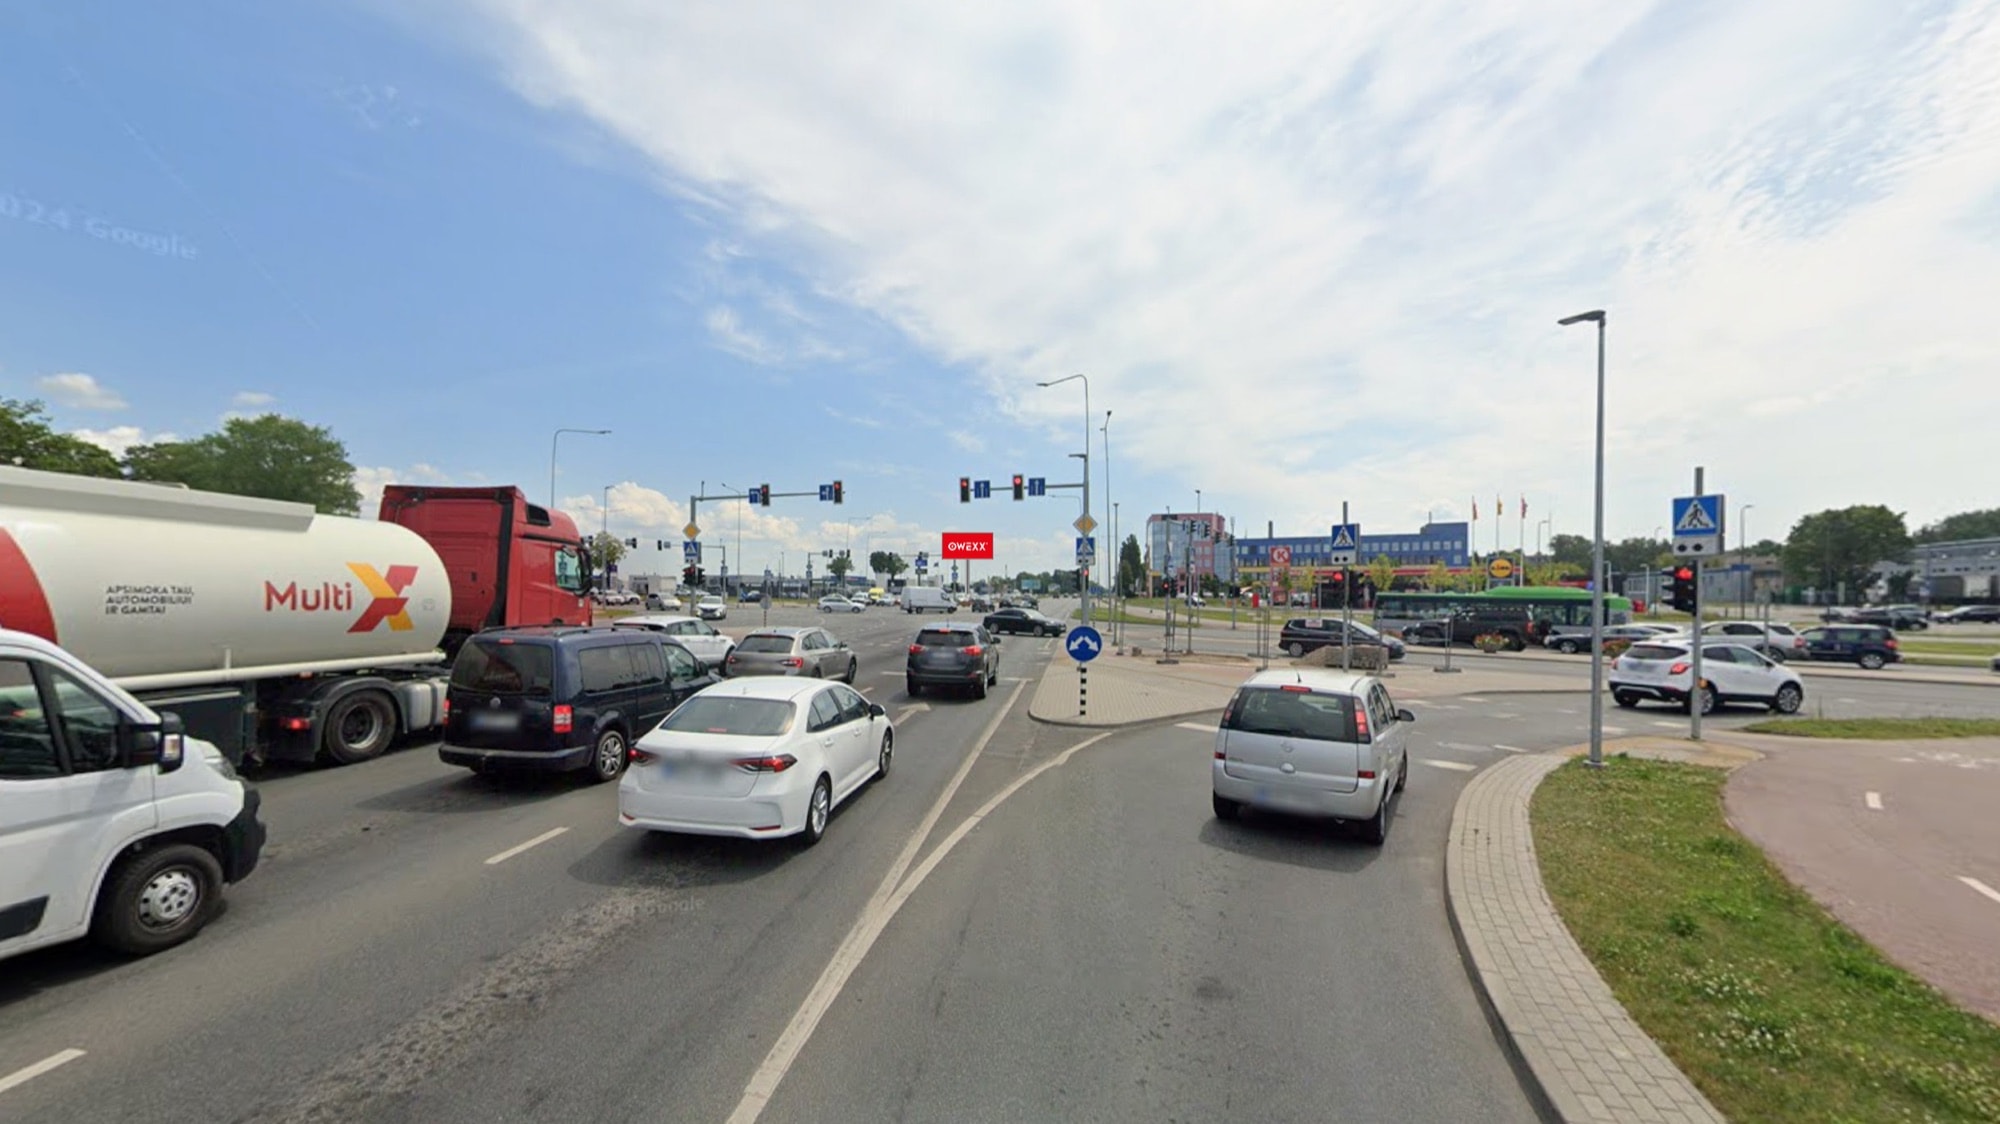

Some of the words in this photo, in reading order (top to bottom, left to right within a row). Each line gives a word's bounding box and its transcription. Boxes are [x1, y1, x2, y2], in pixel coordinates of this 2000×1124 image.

[948, 542, 985, 551] OWEXX
[106, 585, 168, 594] APSIMOKA
[106, 595, 192, 604] AUTOMOBILIUI
[264, 580, 353, 612] Multi
[105, 605, 118, 615] IR
[120, 605, 166, 615] GAMTAI
